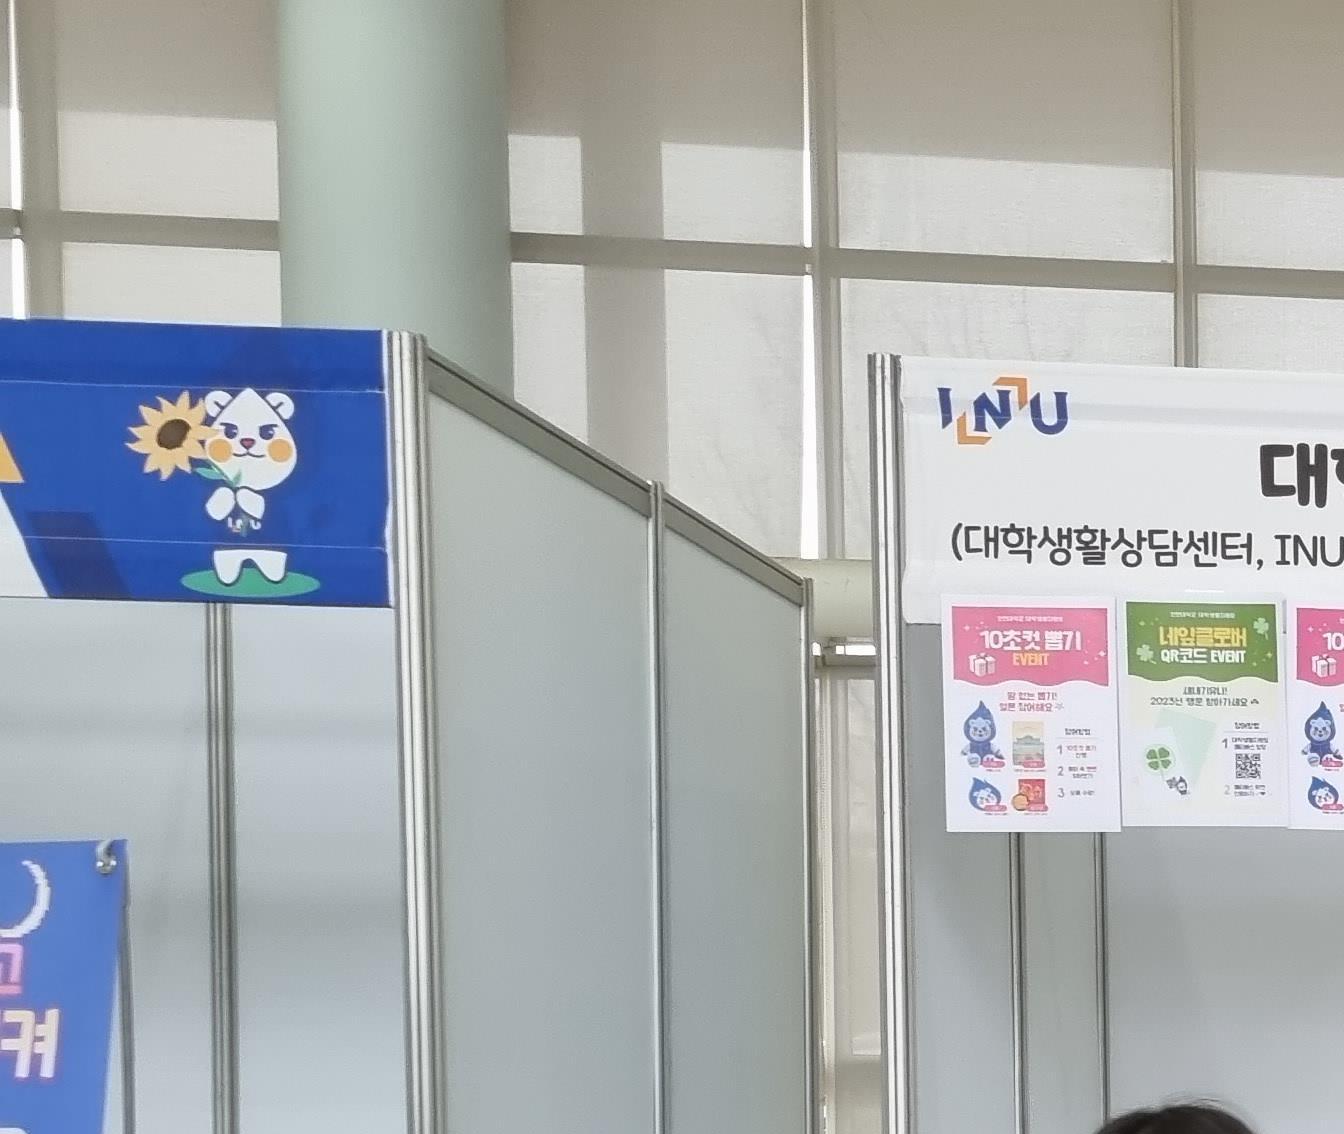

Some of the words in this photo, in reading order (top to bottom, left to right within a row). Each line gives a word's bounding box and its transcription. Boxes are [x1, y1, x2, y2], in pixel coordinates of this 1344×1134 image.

[938, 386, 1069, 436] INU
[952, 523, 1263, 570] (대학생활상담센터,
[1274, 535, 1344, 567] INU
[980, 630, 1040, 651] 10초컷
[1013, 653, 1049, 666] EVENT
[1161, 649, 1208, 664] QR코드
[1211, 650, 1246, 663] EVENT
